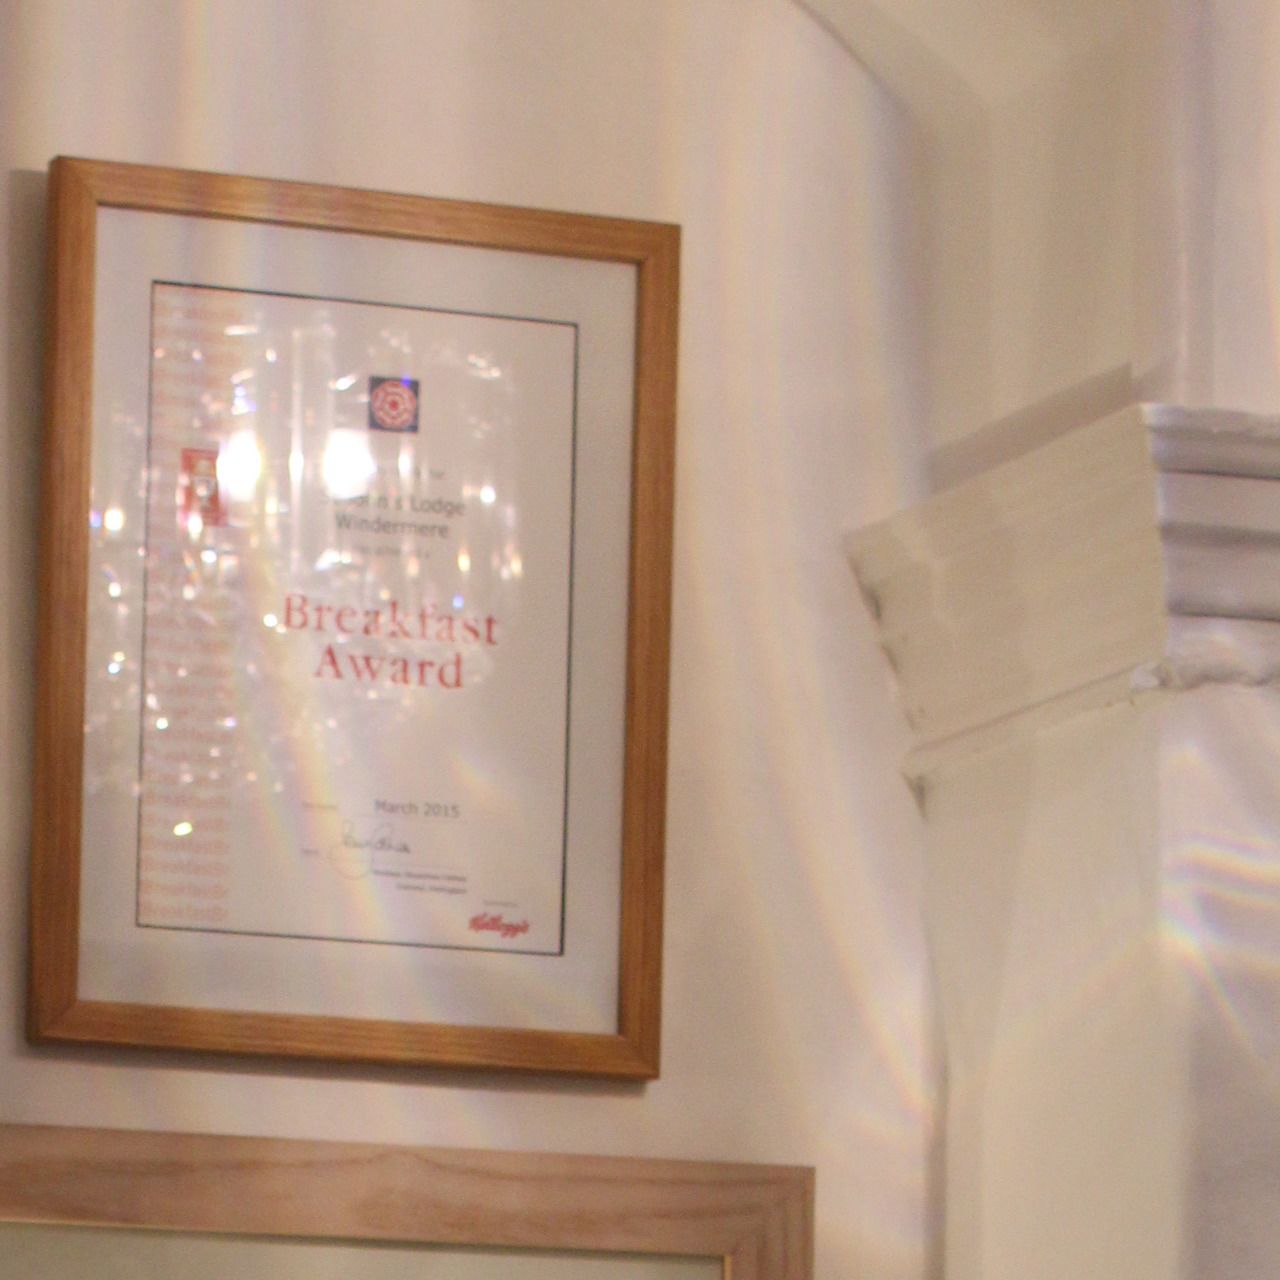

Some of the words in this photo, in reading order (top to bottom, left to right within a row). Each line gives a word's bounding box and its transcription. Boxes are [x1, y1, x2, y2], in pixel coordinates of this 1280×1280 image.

[412, 497, 465, 518] Lodge
[336, 514, 448, 537] Windermere
[285, 592, 498, 646] Breakfast
[314, 644, 463, 689] Award
[374, 800, 419, 815] March
[424, 803, 460, 818] 2015
